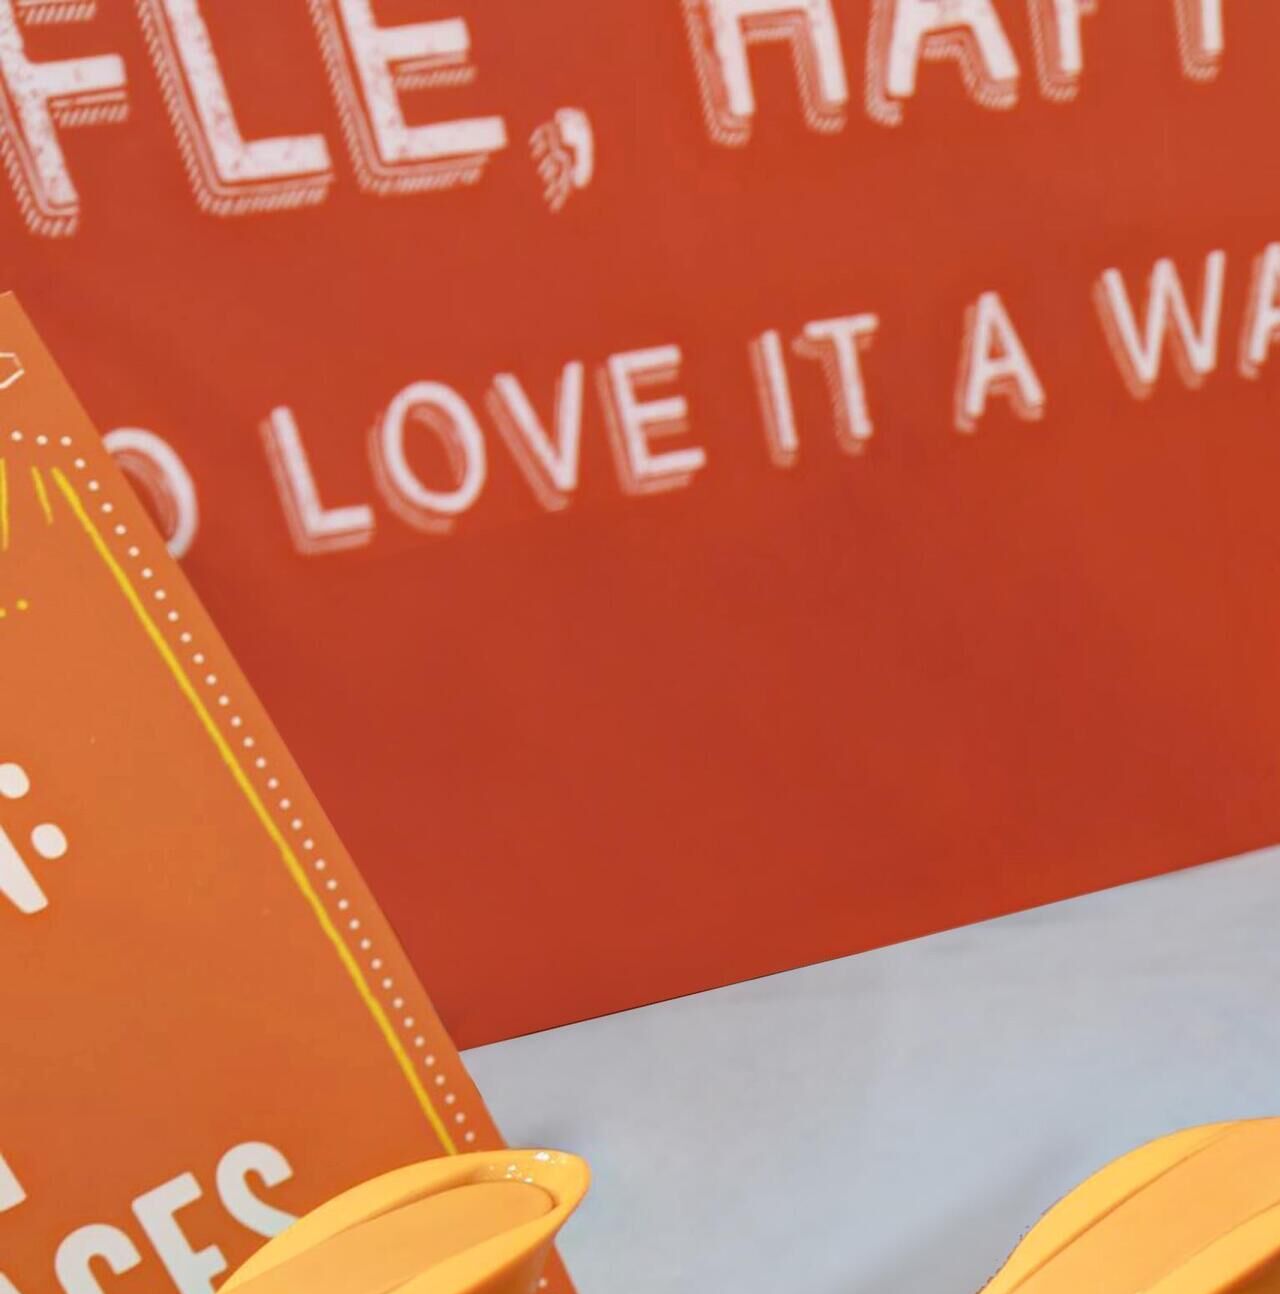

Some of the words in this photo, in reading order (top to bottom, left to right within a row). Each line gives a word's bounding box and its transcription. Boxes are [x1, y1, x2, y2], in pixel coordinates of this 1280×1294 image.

[260, 344, 706, 556] LOVE
[748, 312, 880, 468] IT
[954, 291, 1046, 433] A
